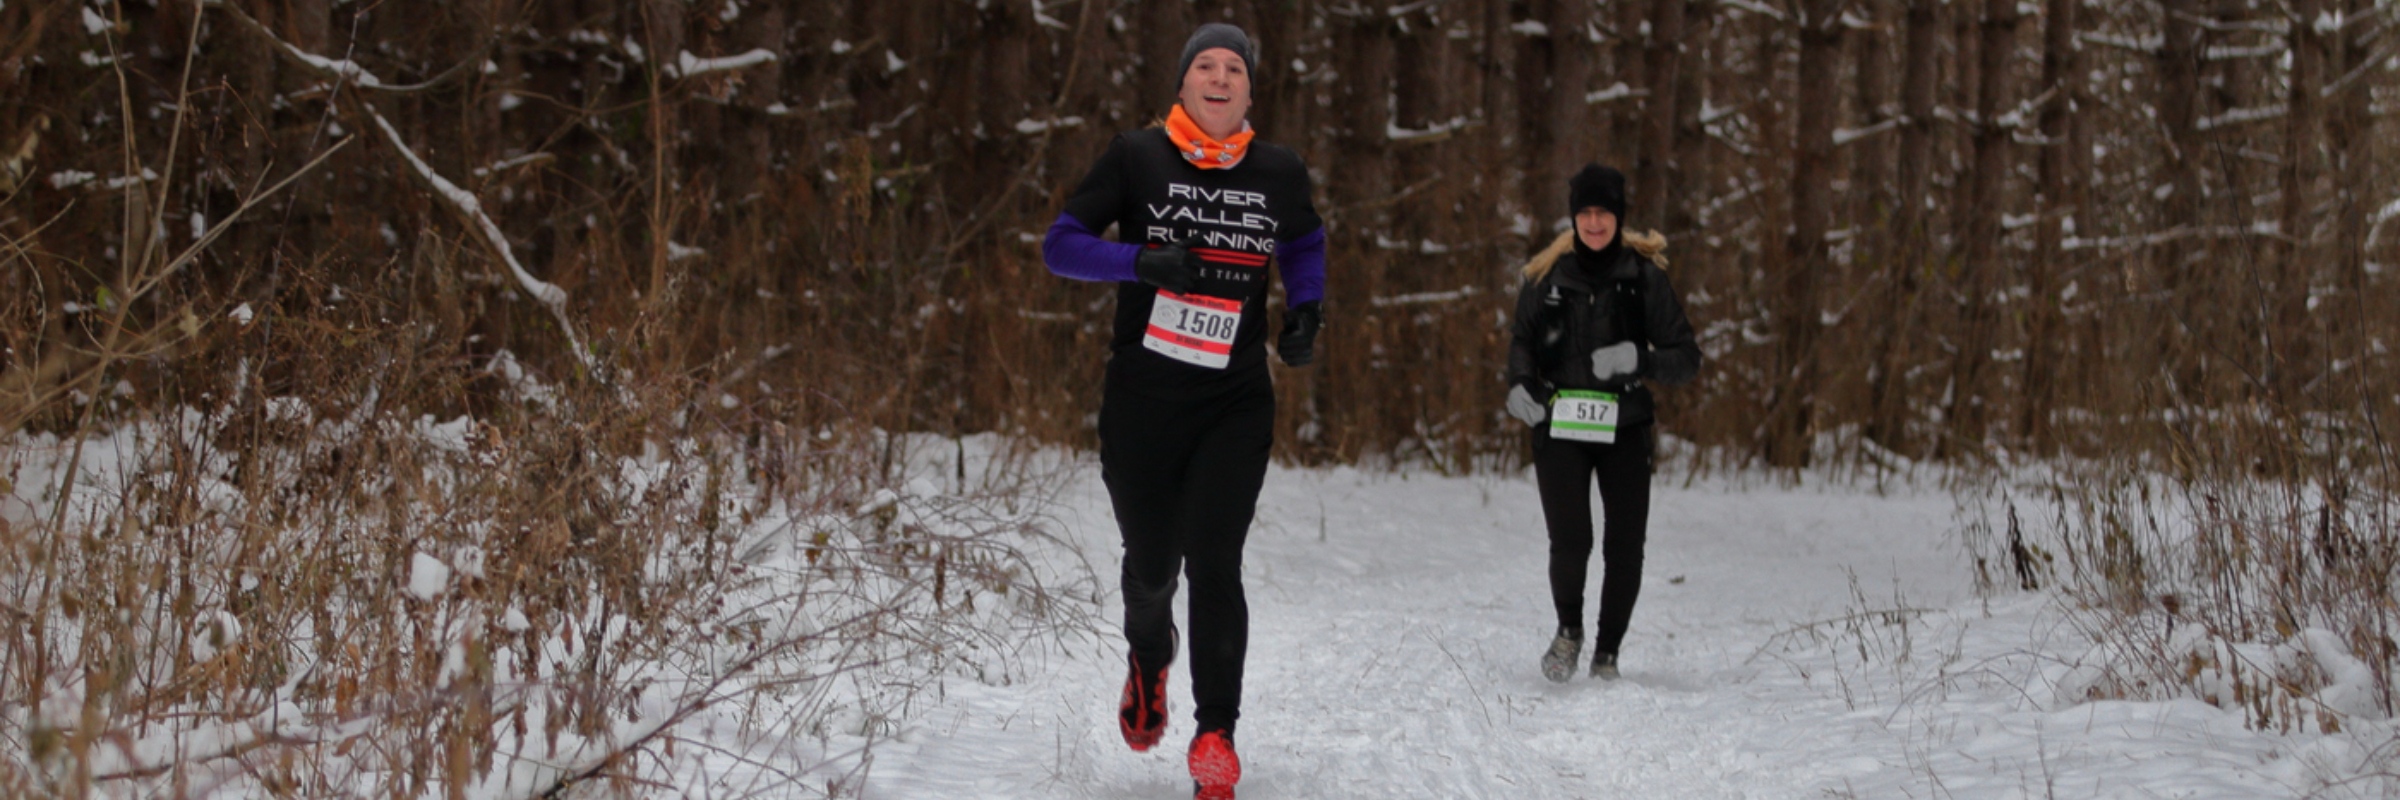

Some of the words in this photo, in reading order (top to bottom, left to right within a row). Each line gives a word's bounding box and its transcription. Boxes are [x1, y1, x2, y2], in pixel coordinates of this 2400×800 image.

[1168, 183, 1267, 209] RIVER
[1147, 203, 1279, 233] VALLEY
[1216, 268, 1251, 282] TEAM
[1175, 308, 1236, 340] 1508
[1576, 402, 1609, 422] 517
